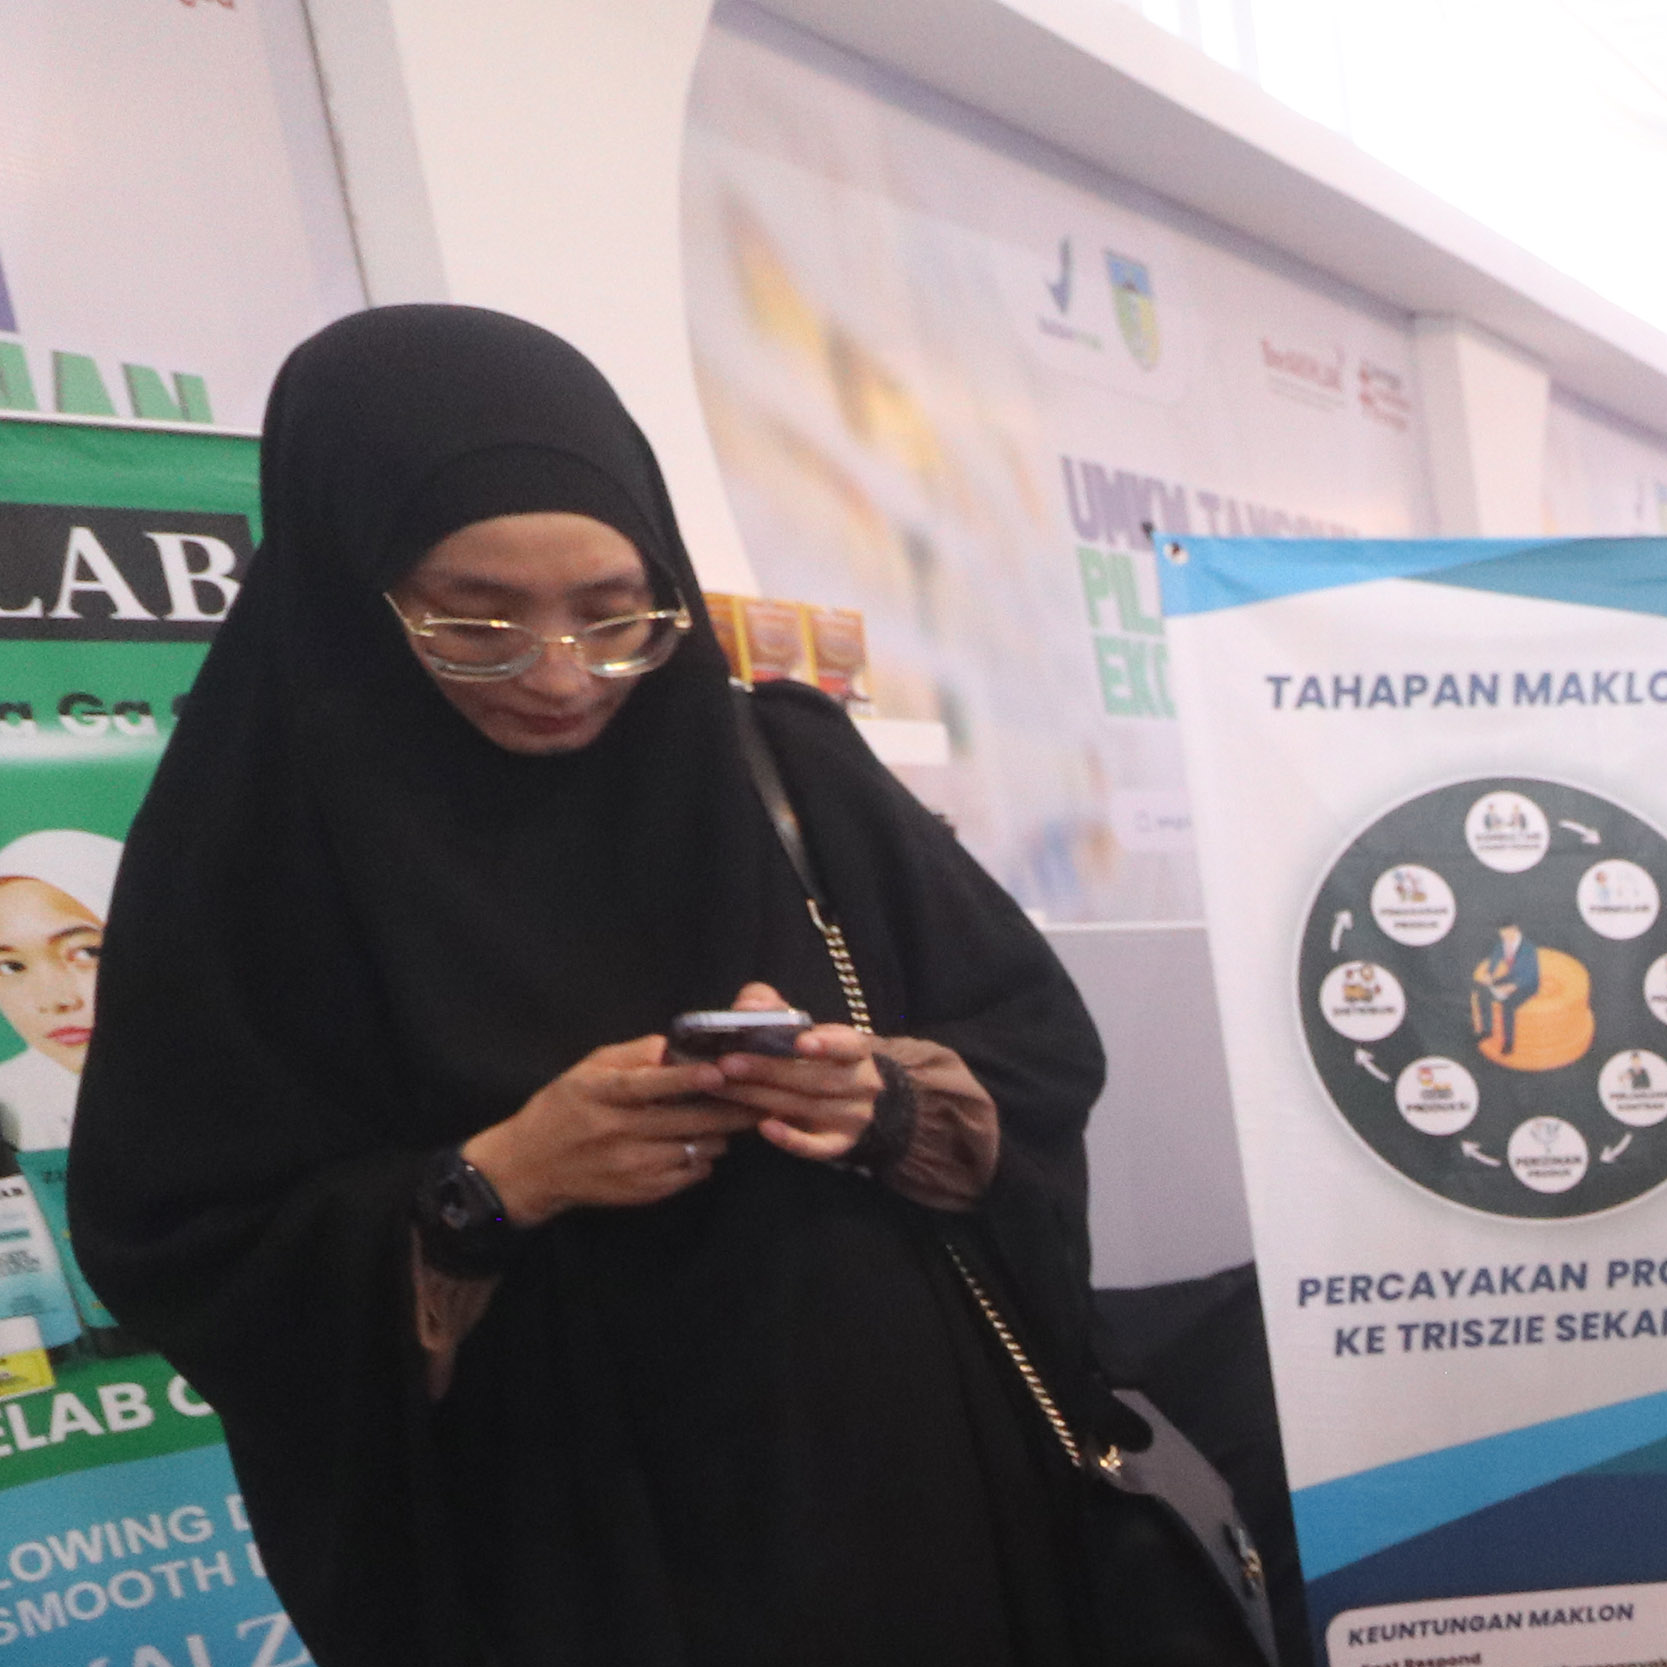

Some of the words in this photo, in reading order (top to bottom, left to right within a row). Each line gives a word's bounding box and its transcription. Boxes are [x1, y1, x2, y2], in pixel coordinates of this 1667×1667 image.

[1265, 673, 1500, 711] TAHAPAN
[1298, 1263, 1588, 1307] PERCAYAKAN
[1334, 1325, 1385, 1358] KE
[1397, 1315, 1545, 1353] TRISZIE
[1347, 1612, 1523, 1646] KEUNTUNGAN
[1528, 1604, 1635, 1629] MAKLON
